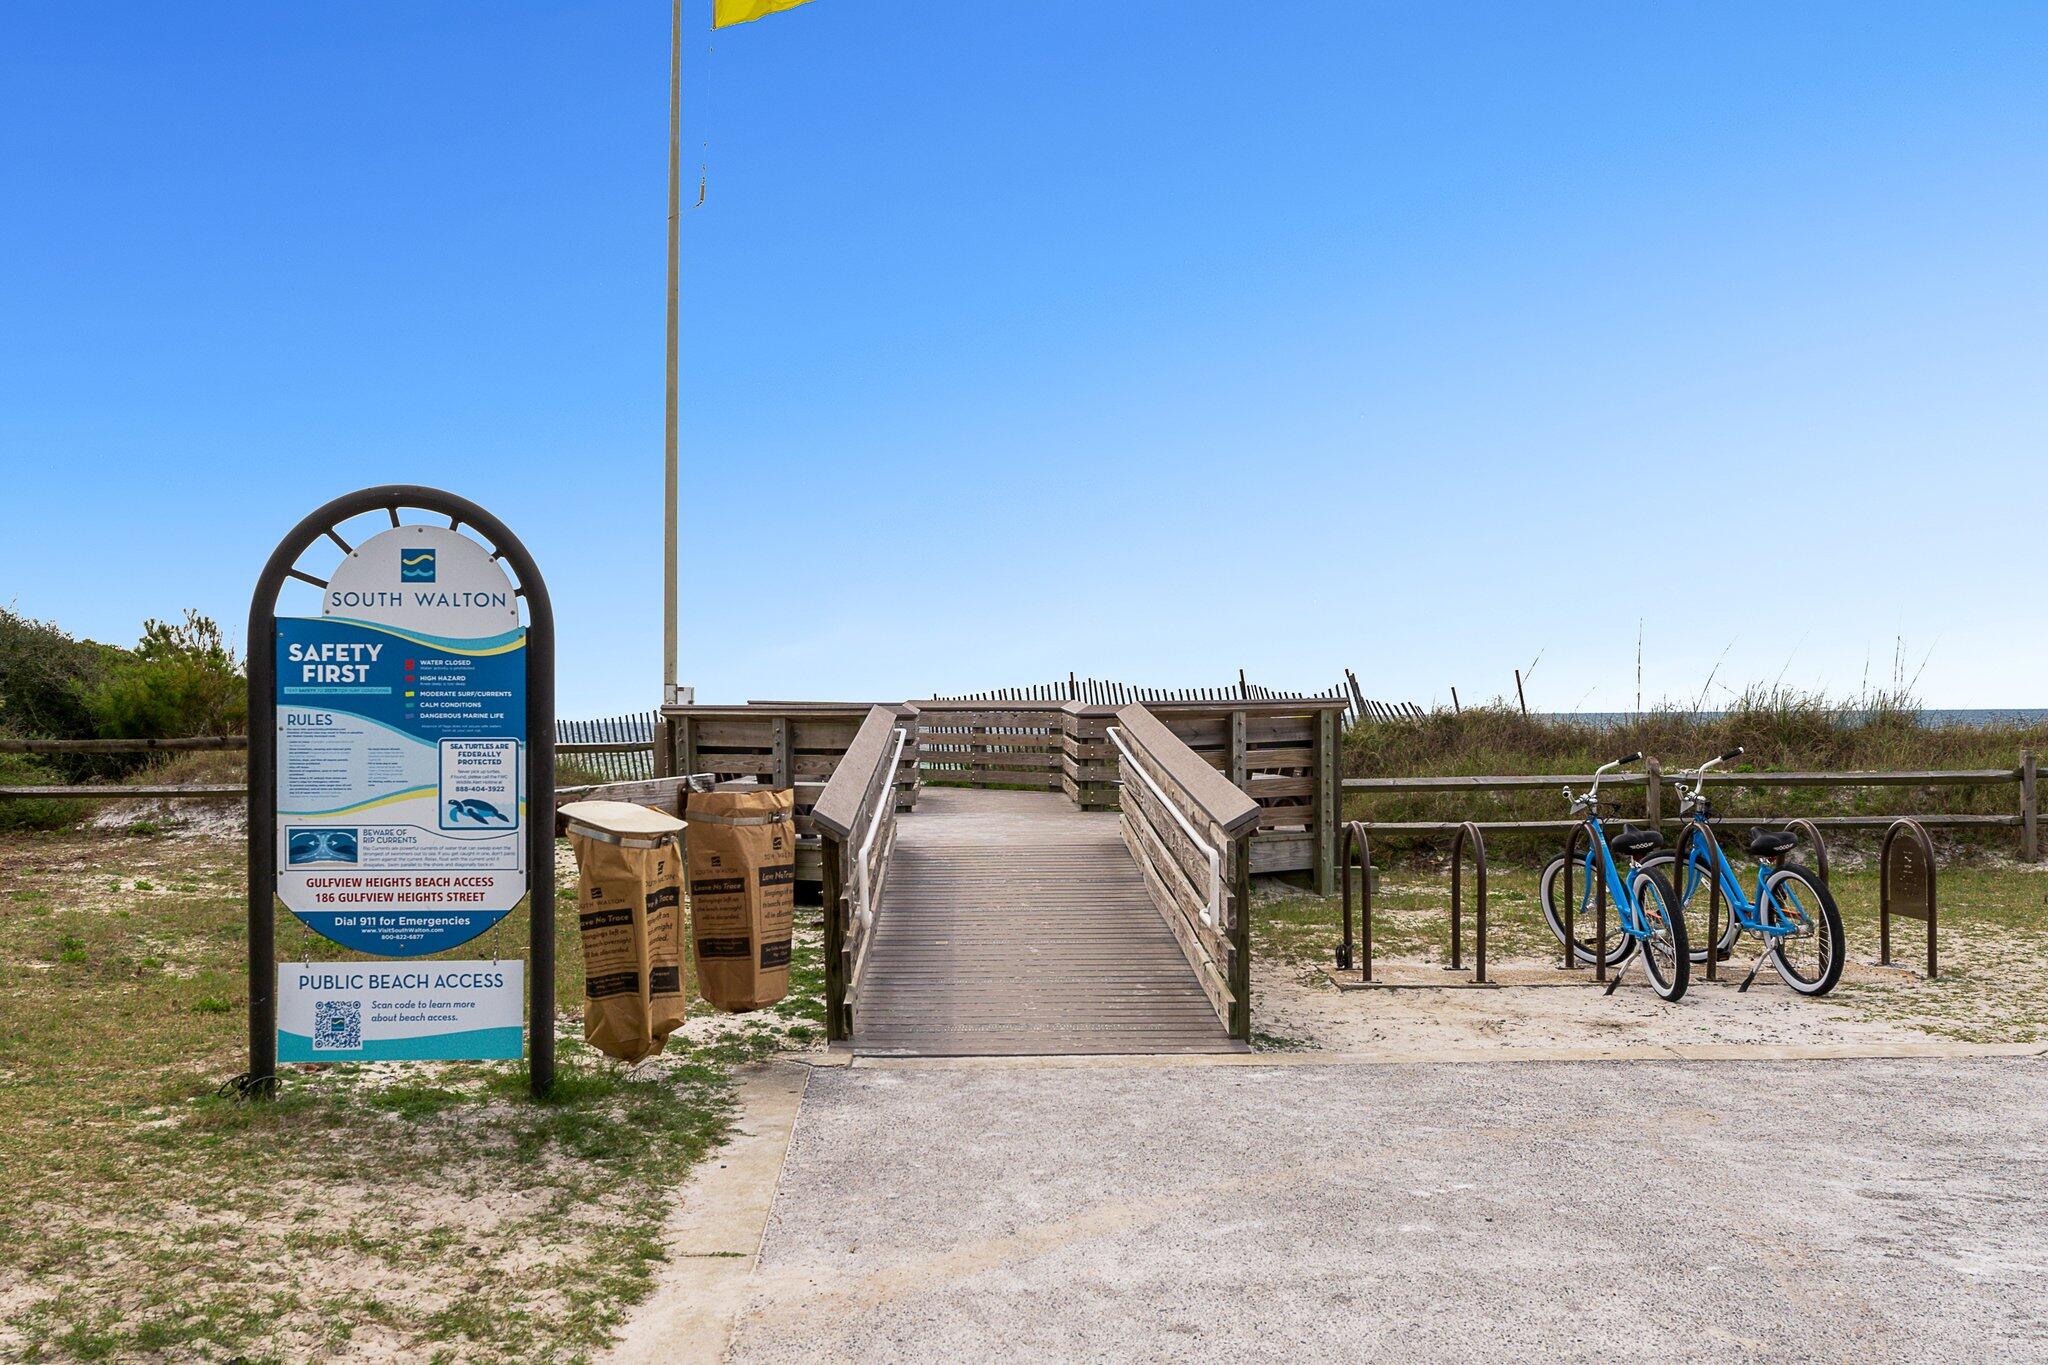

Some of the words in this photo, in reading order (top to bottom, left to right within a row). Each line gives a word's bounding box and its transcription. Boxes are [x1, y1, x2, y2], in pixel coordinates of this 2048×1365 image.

[332, 592, 402, 607] SOUTH
[414, 592, 506, 607] WALTON
[288, 644, 383, 662] SAFETY
[303, 664, 370, 682] FIRST
[288, 714, 332, 726] RULES
[306, 878, 362, 888] GULFVIEW
[366, 878, 411, 888] HEIGHTS
[415, 878, 450, 888] BEACH
[454, 878, 494, 888] ACCESS
[316, 892, 335, 902] 186
[338, 892, 394, 902] GULFVIEW
[398, 892, 444, 902] HEIGHTS
[447, 892, 485, 902] STREET
[335, 916, 356, 926] Dial
[360, 916, 376, 926] 911
[380, 916, 396, 926] for
[399, 916, 470, 927] Emergencies
[299, 975, 364, 990] PUBLIC
[369, 974, 429, 989] BEACH
[434, 973, 503, 988] ACCESS
[371, 1001, 392, 1009] Scan
[394, 1001, 416, 1009] code
[429, 1000, 451, 1008] learn
[371, 1013, 397, 1022] about
[399, 1013, 426, 1022] beach
